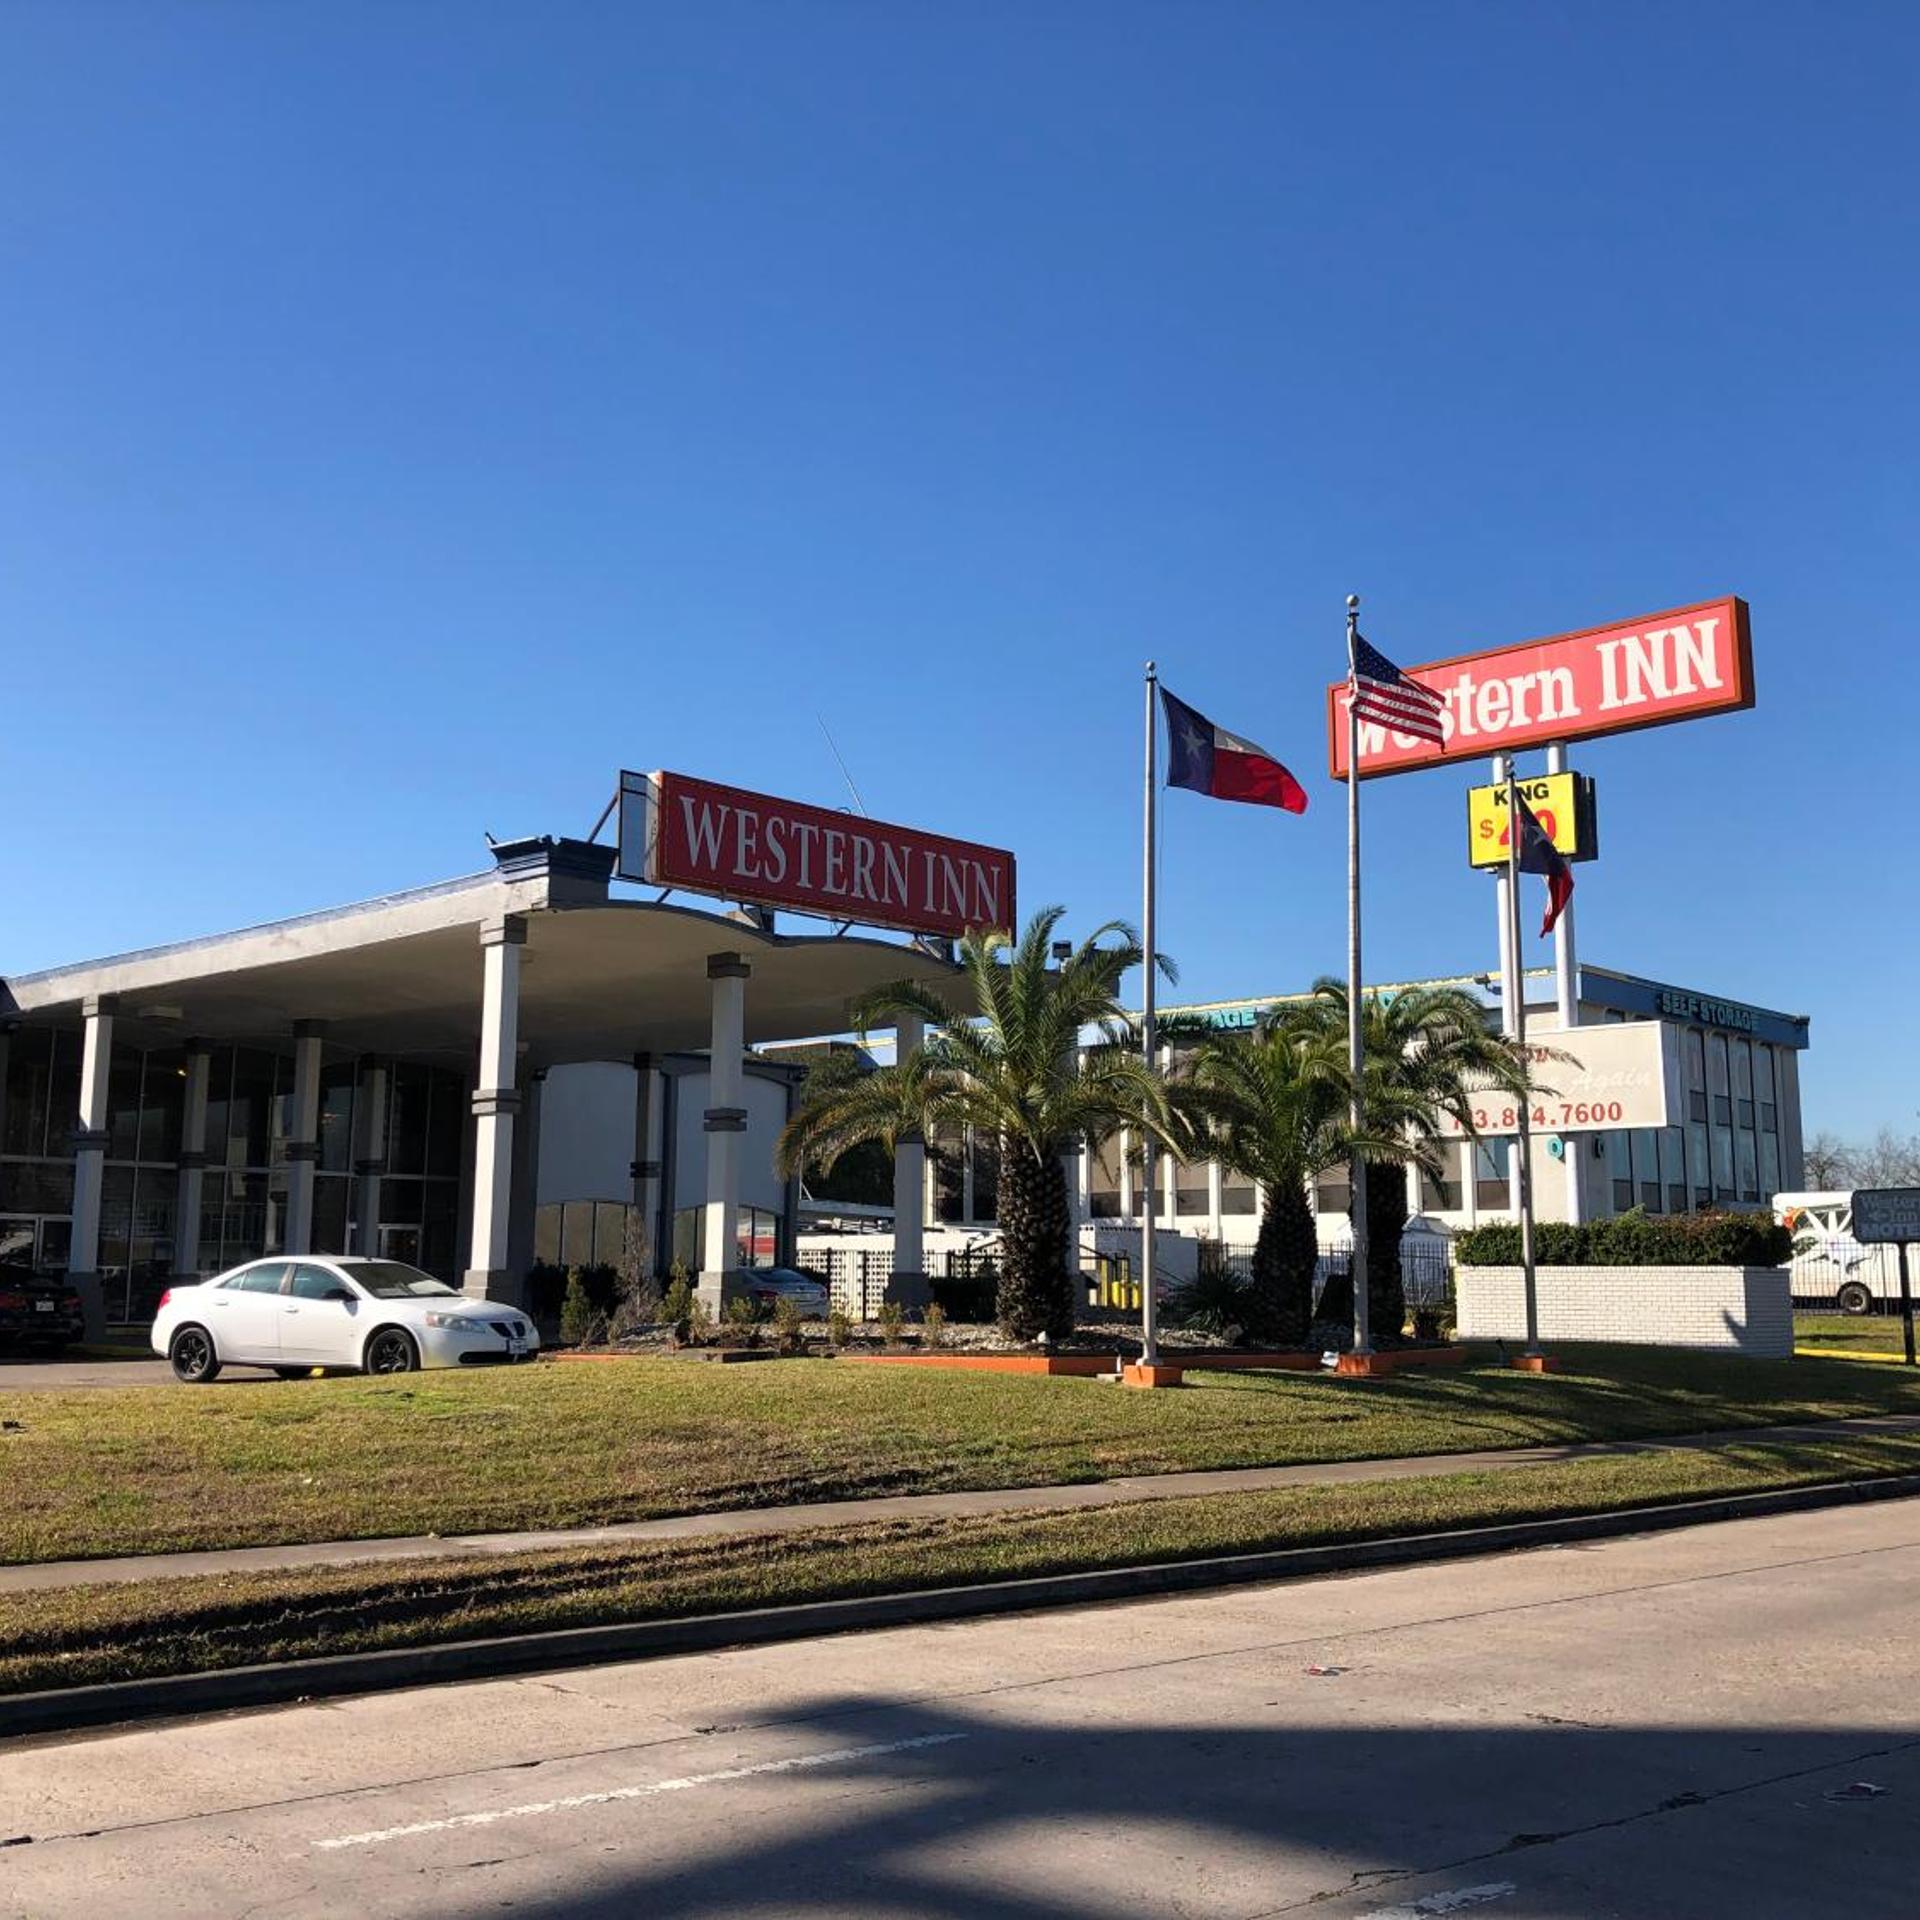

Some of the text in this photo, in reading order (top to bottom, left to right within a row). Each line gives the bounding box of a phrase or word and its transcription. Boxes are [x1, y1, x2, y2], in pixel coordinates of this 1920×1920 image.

[1597, 618, 1723, 710] INN
[1494, 783, 1549, 806] KNG
[678, 794, 1001, 924] WESTERN INN
[1662, 991, 1698, 1017] SELF
[1570, 1067, 1651, 1096] Again
[1453, 1101, 1623, 1130] 3.84.7600
